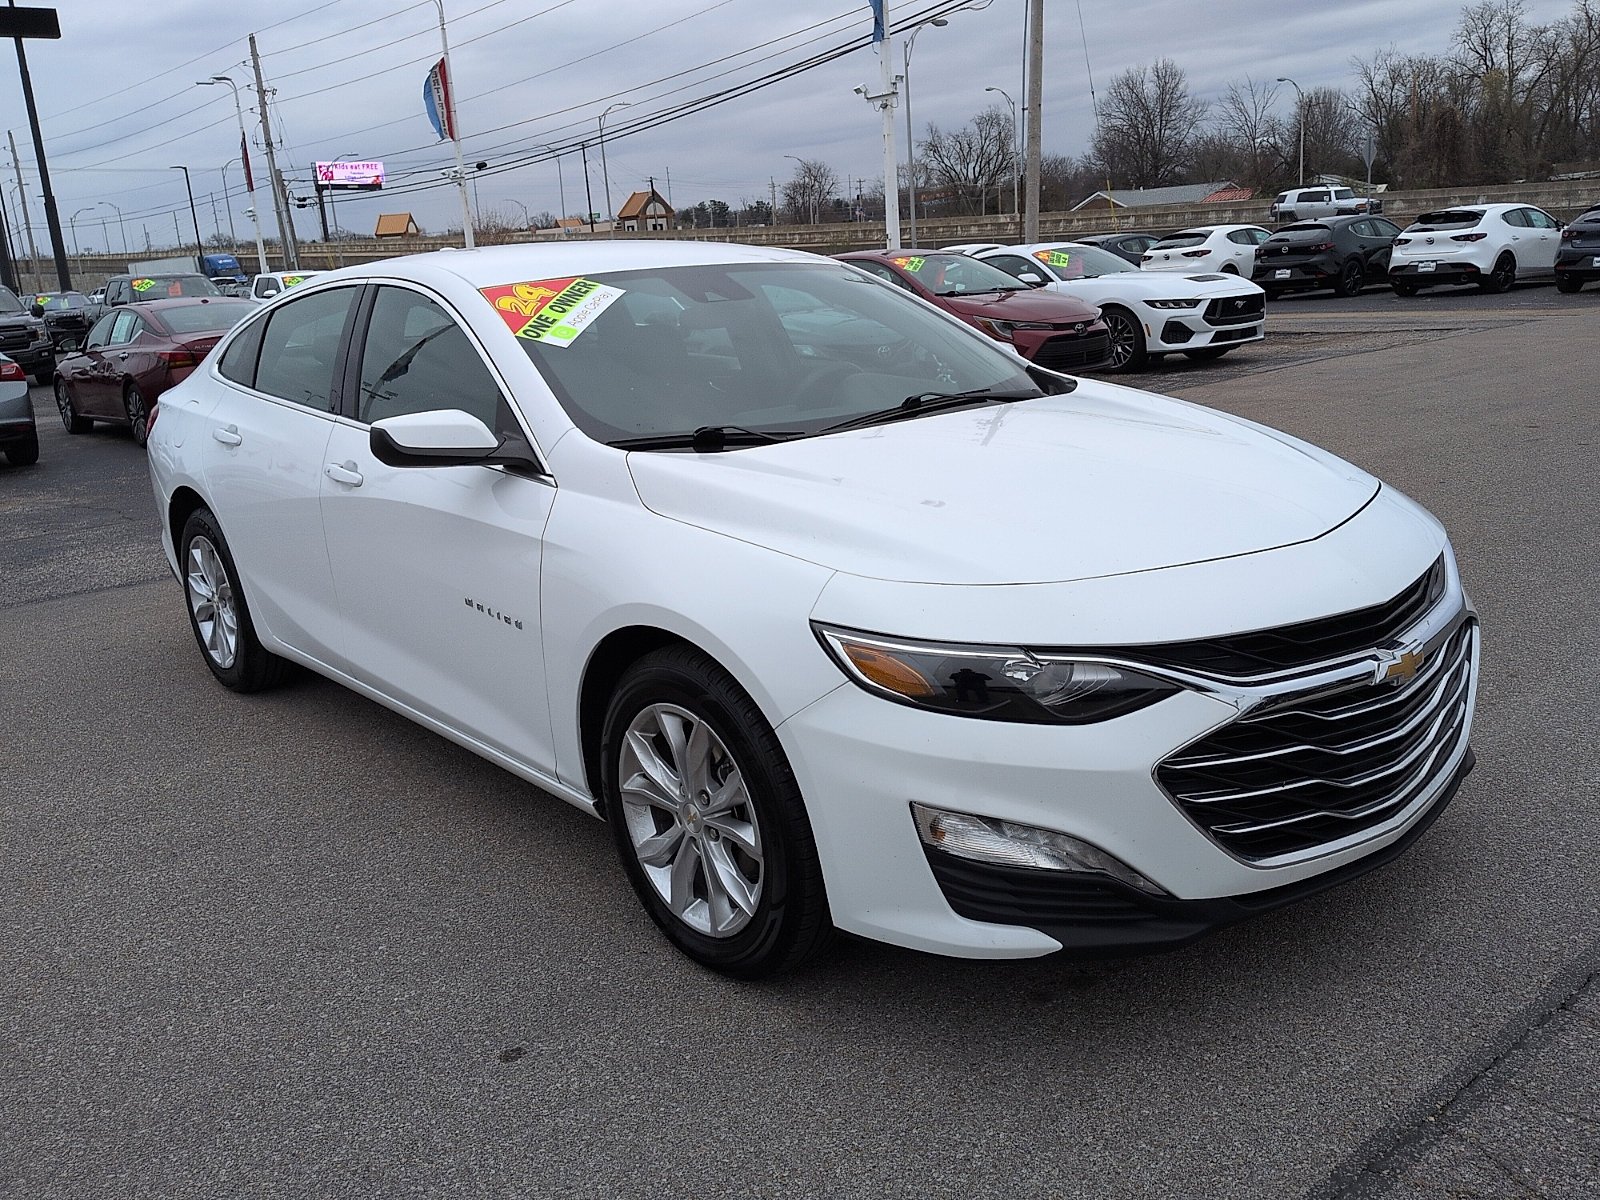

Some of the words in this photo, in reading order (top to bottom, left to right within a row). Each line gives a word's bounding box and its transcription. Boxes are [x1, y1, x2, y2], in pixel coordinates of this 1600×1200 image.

[495, 284, 558, 317] 24
[522, 314, 558, 339] ONE
[551, 281, 597, 314] OWNER
[567, 309, 590, 327] Apple
[585, 290, 613, 311] CarPlay
[464, 596, 523, 630] MALIBU
